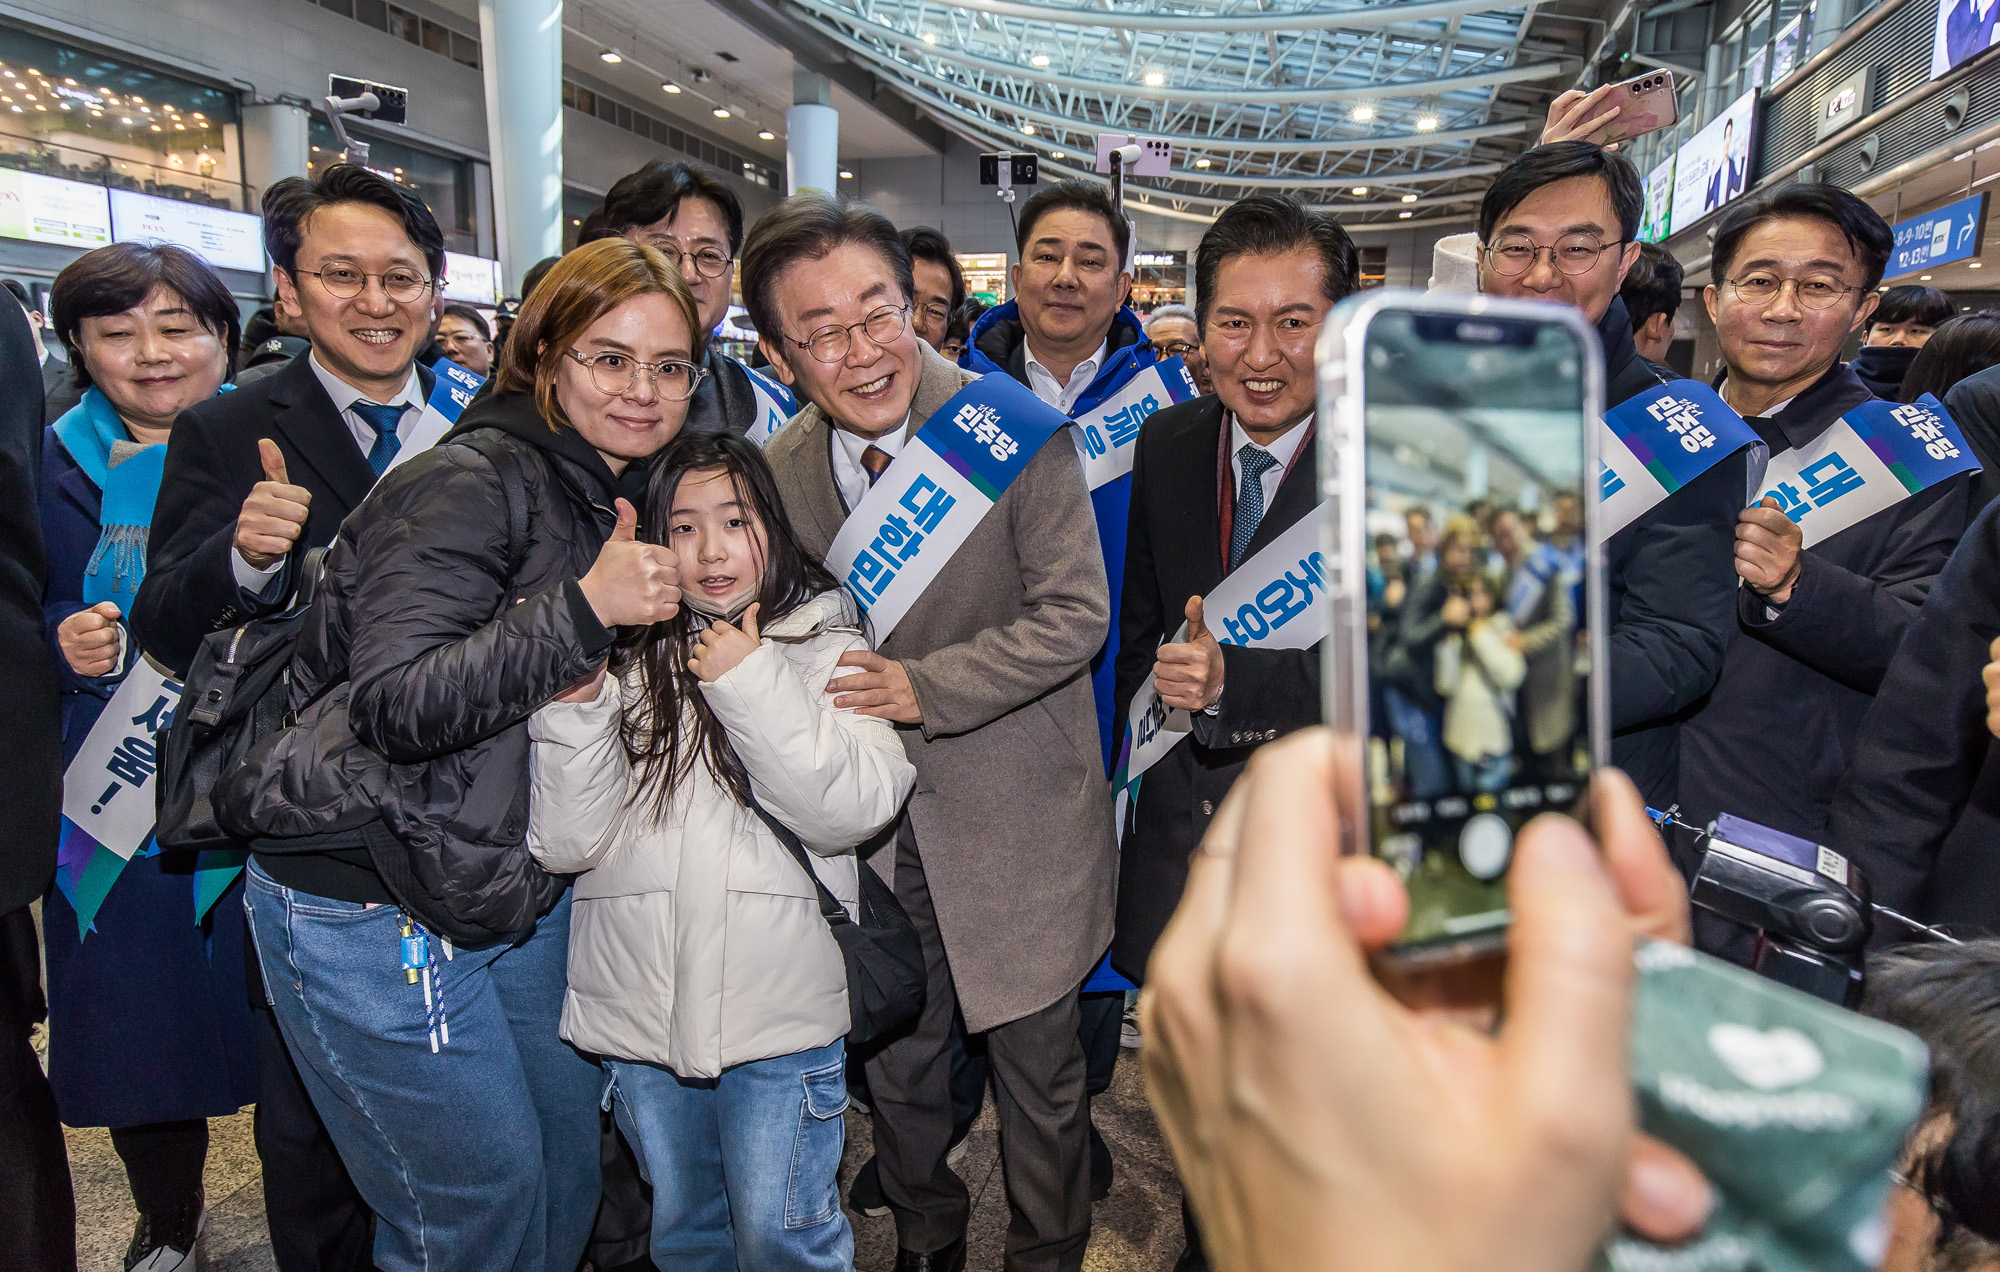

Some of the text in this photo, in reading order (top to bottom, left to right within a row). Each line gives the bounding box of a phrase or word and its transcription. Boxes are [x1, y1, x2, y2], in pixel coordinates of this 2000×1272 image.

[952, 403, 1019, 462] 민주당
[977, 403, 1002, 422] 더불어
[1645, 395, 1718, 454] 민주당
[1677, 397, 1704, 417] 더불어
[1889, 404, 1961, 461] 민주당
